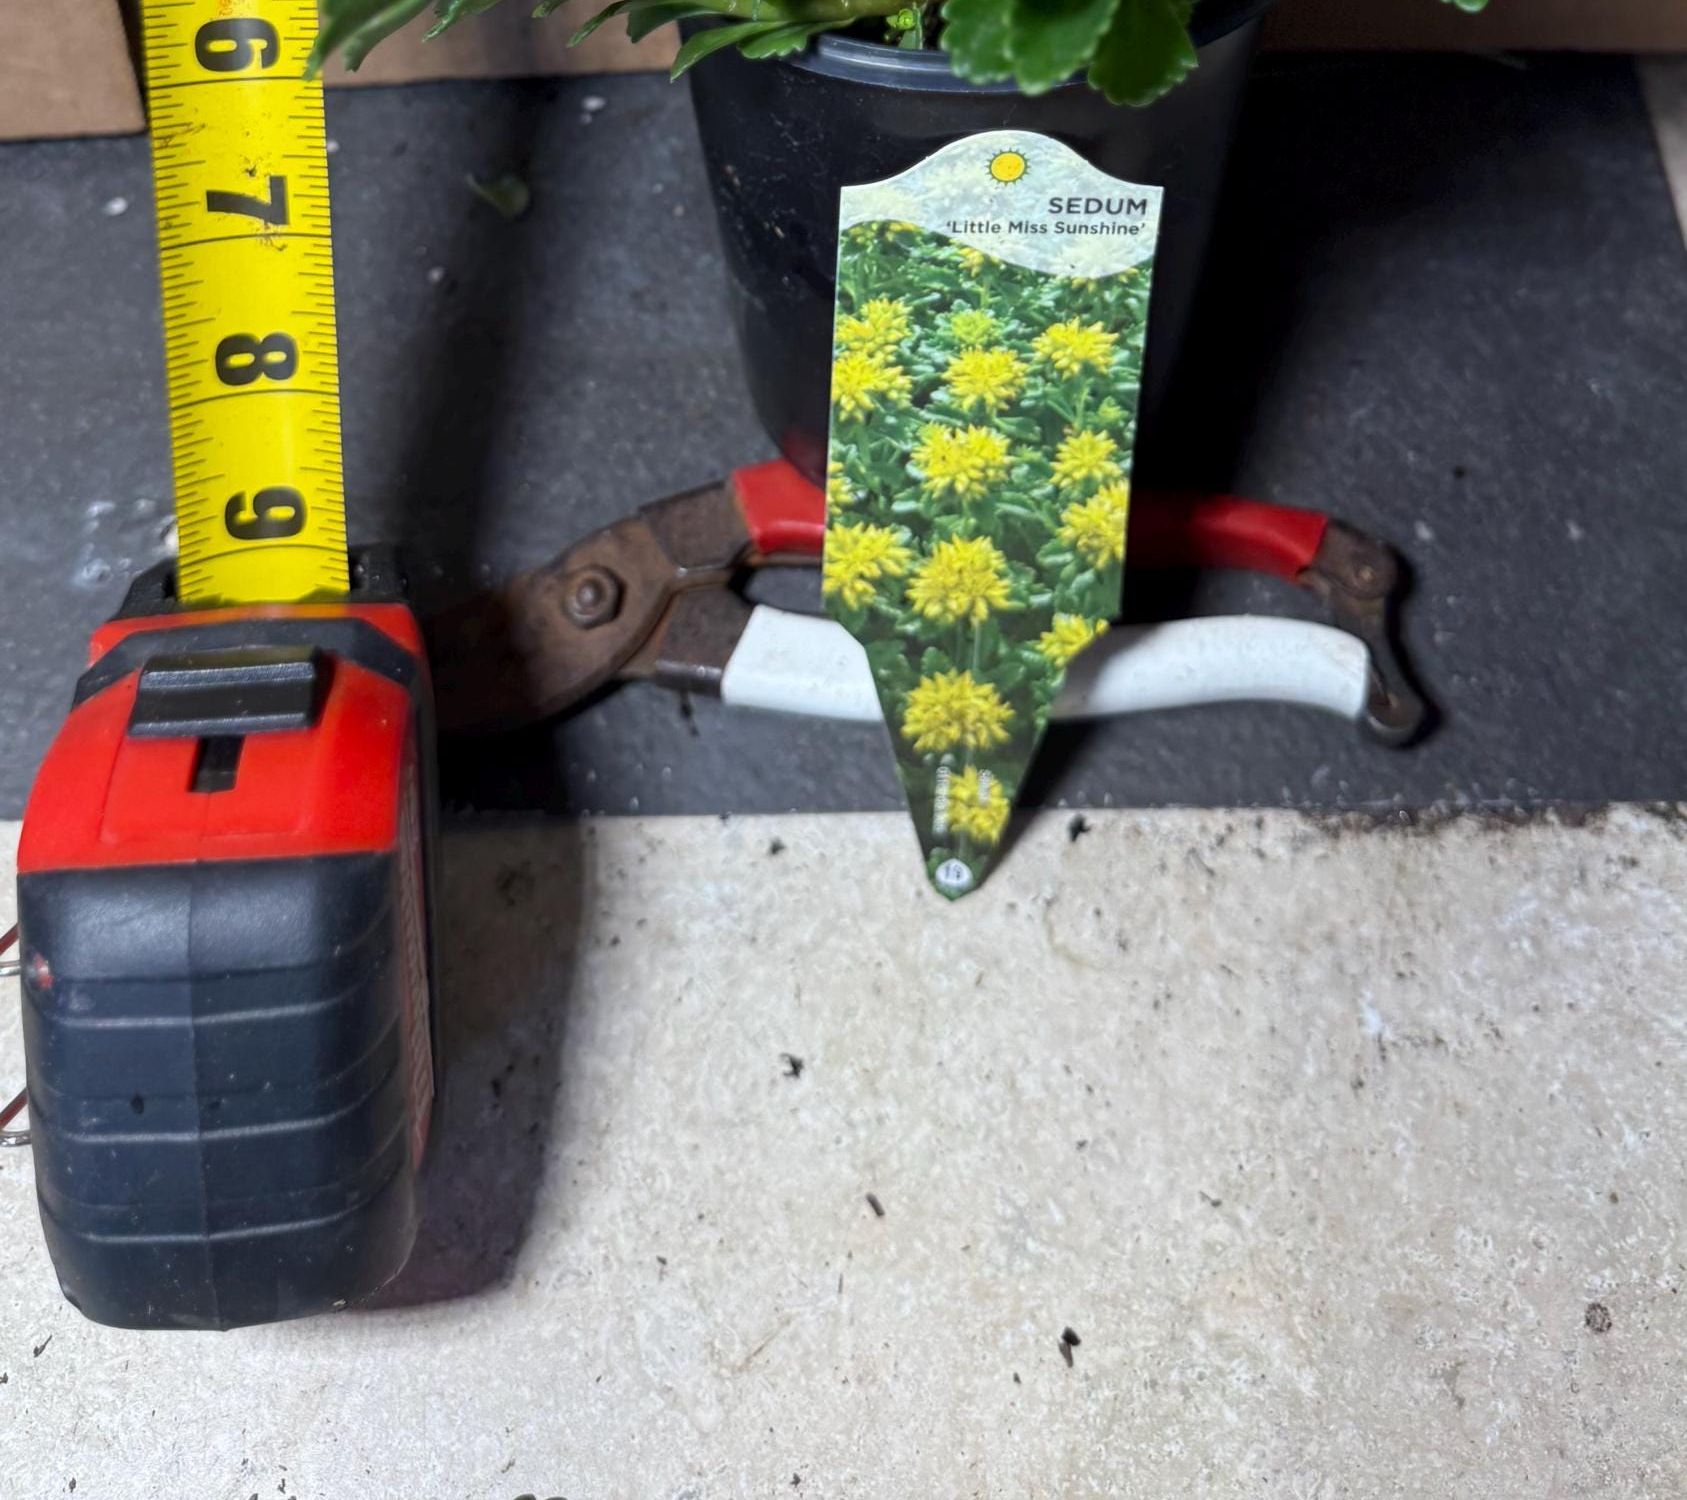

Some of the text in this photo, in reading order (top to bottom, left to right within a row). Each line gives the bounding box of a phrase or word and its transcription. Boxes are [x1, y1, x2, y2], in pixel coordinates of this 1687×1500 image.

[194, 16, 280, 73] 6
[205, 175, 291, 226] 7
[1047, 197, 1148, 215] SEDUM
[1008, 221, 1047, 234] Miss
[215, 331, 299, 386] 8
[223, 485, 308, 541] 9
